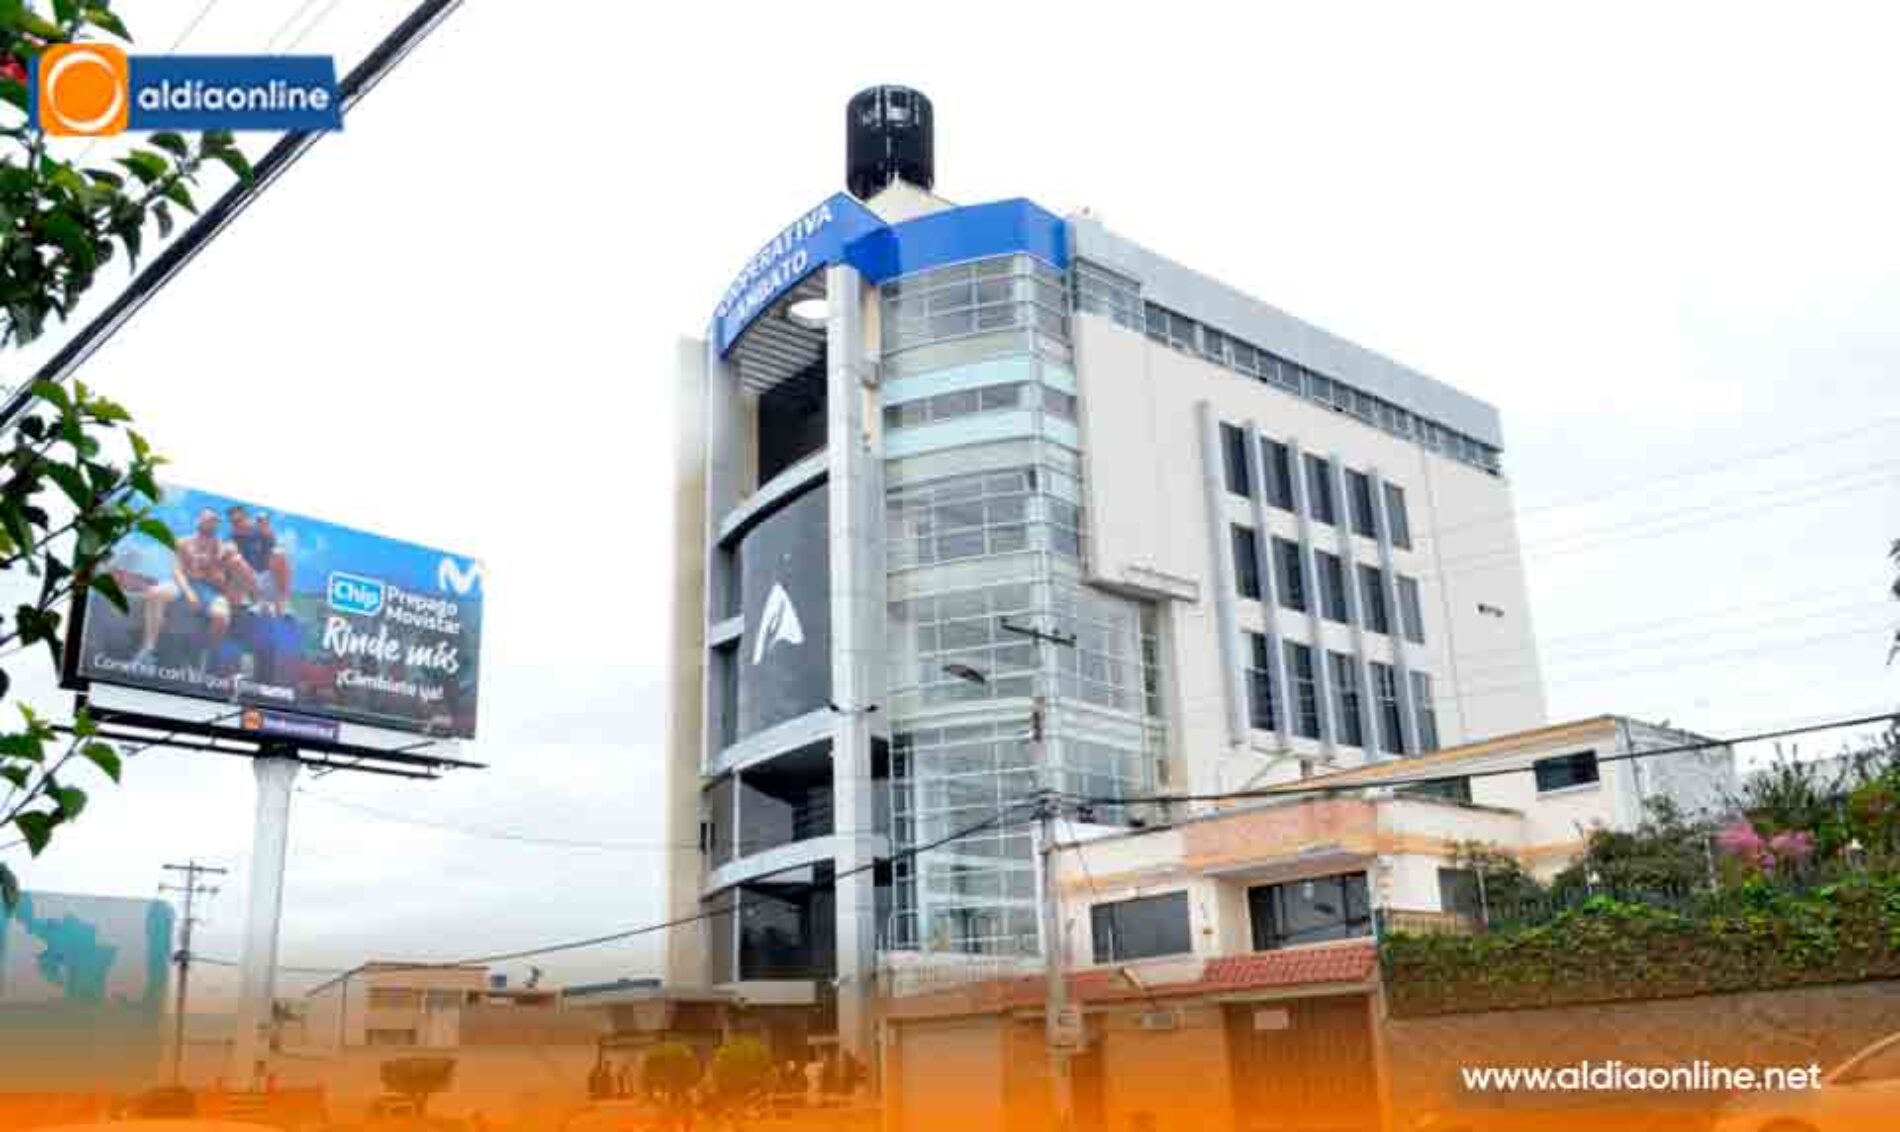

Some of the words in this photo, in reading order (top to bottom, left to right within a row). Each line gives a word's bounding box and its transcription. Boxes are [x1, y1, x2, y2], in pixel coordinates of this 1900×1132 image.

[334, 580, 379, 610] Chip
[387, 585, 459, 619] Prepago
[385, 605, 461, 635] Movistar
[321, 615, 400, 662] Rinde
[405, 640, 460, 674] más
